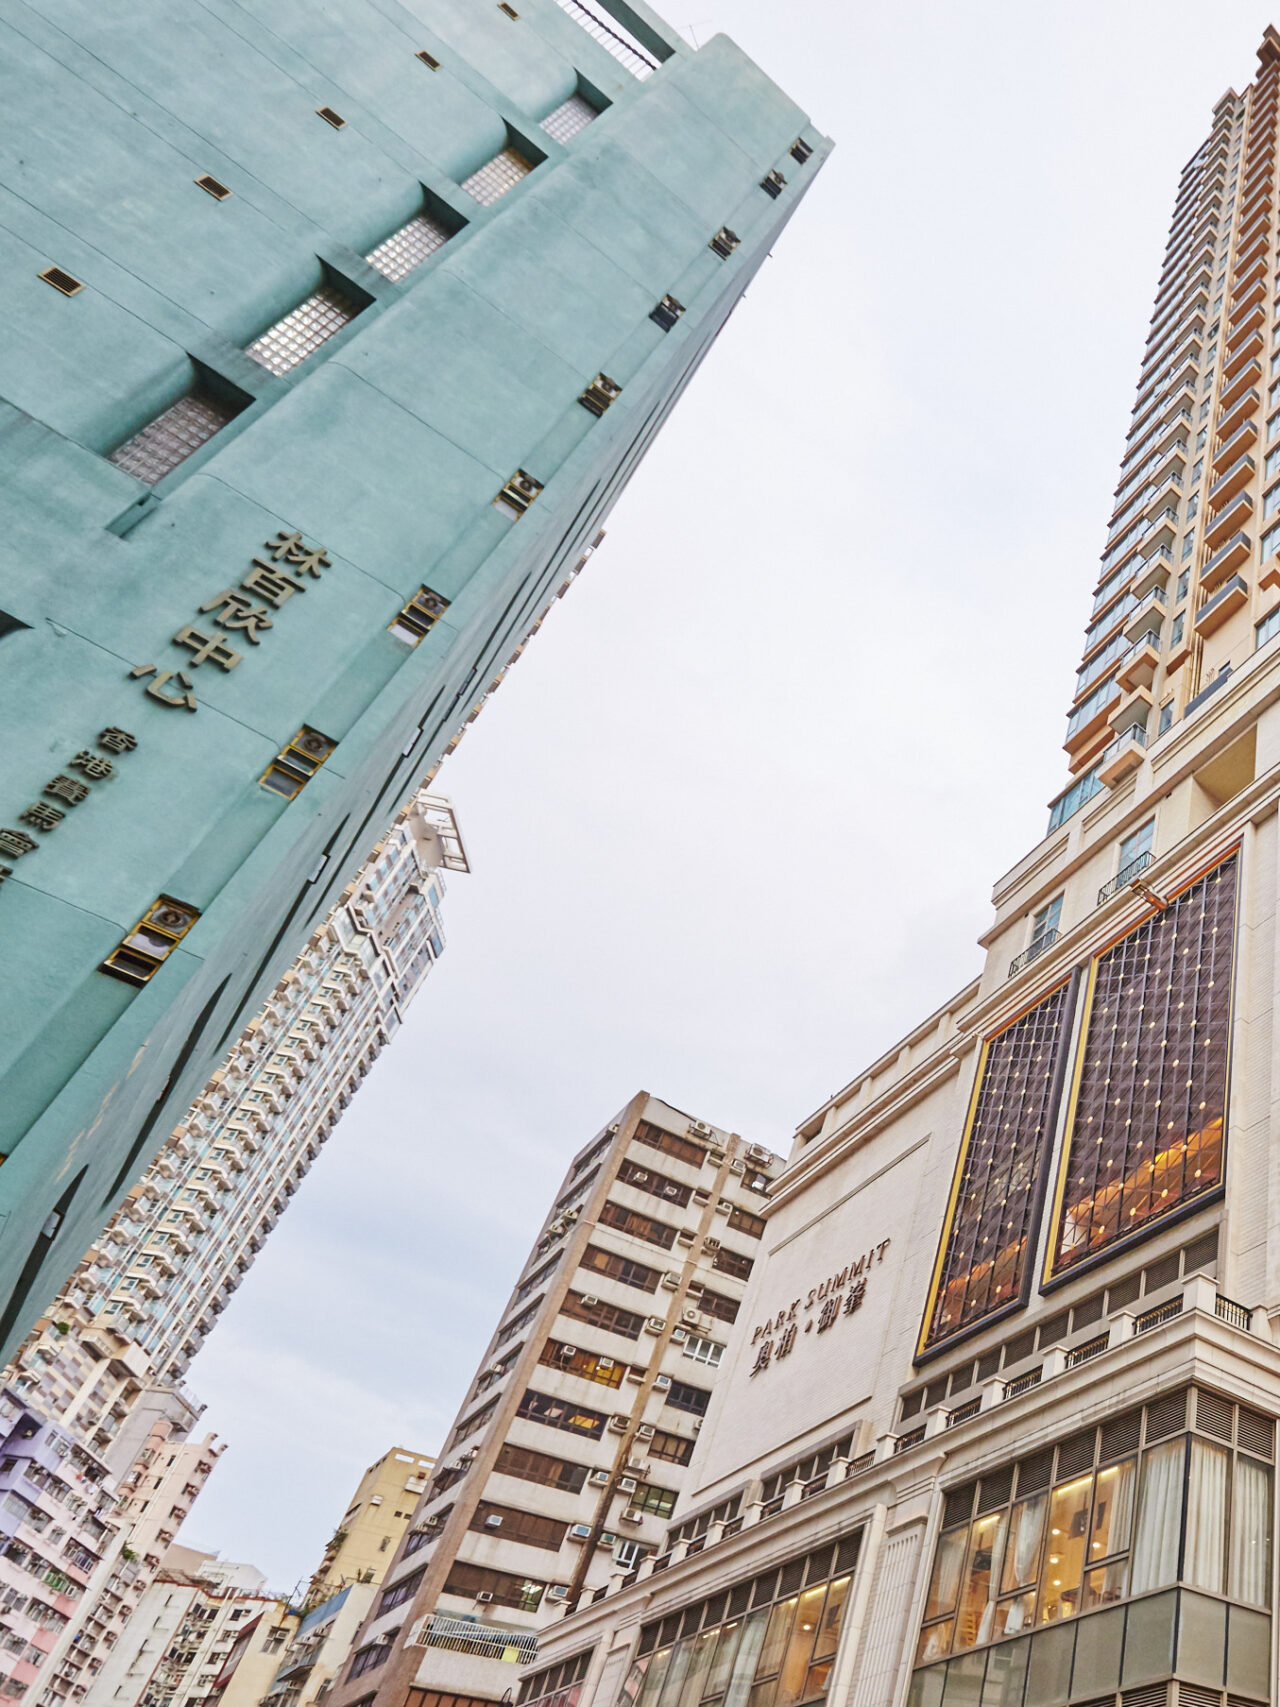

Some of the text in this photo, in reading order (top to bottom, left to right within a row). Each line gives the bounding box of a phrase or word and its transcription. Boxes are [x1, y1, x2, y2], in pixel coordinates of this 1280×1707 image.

[128, 530, 332, 713] 林百欣中心
[0, 726, 138, 884] 香港賽馬會
[750, 1238, 891, 1345] PARK SUMMIT
